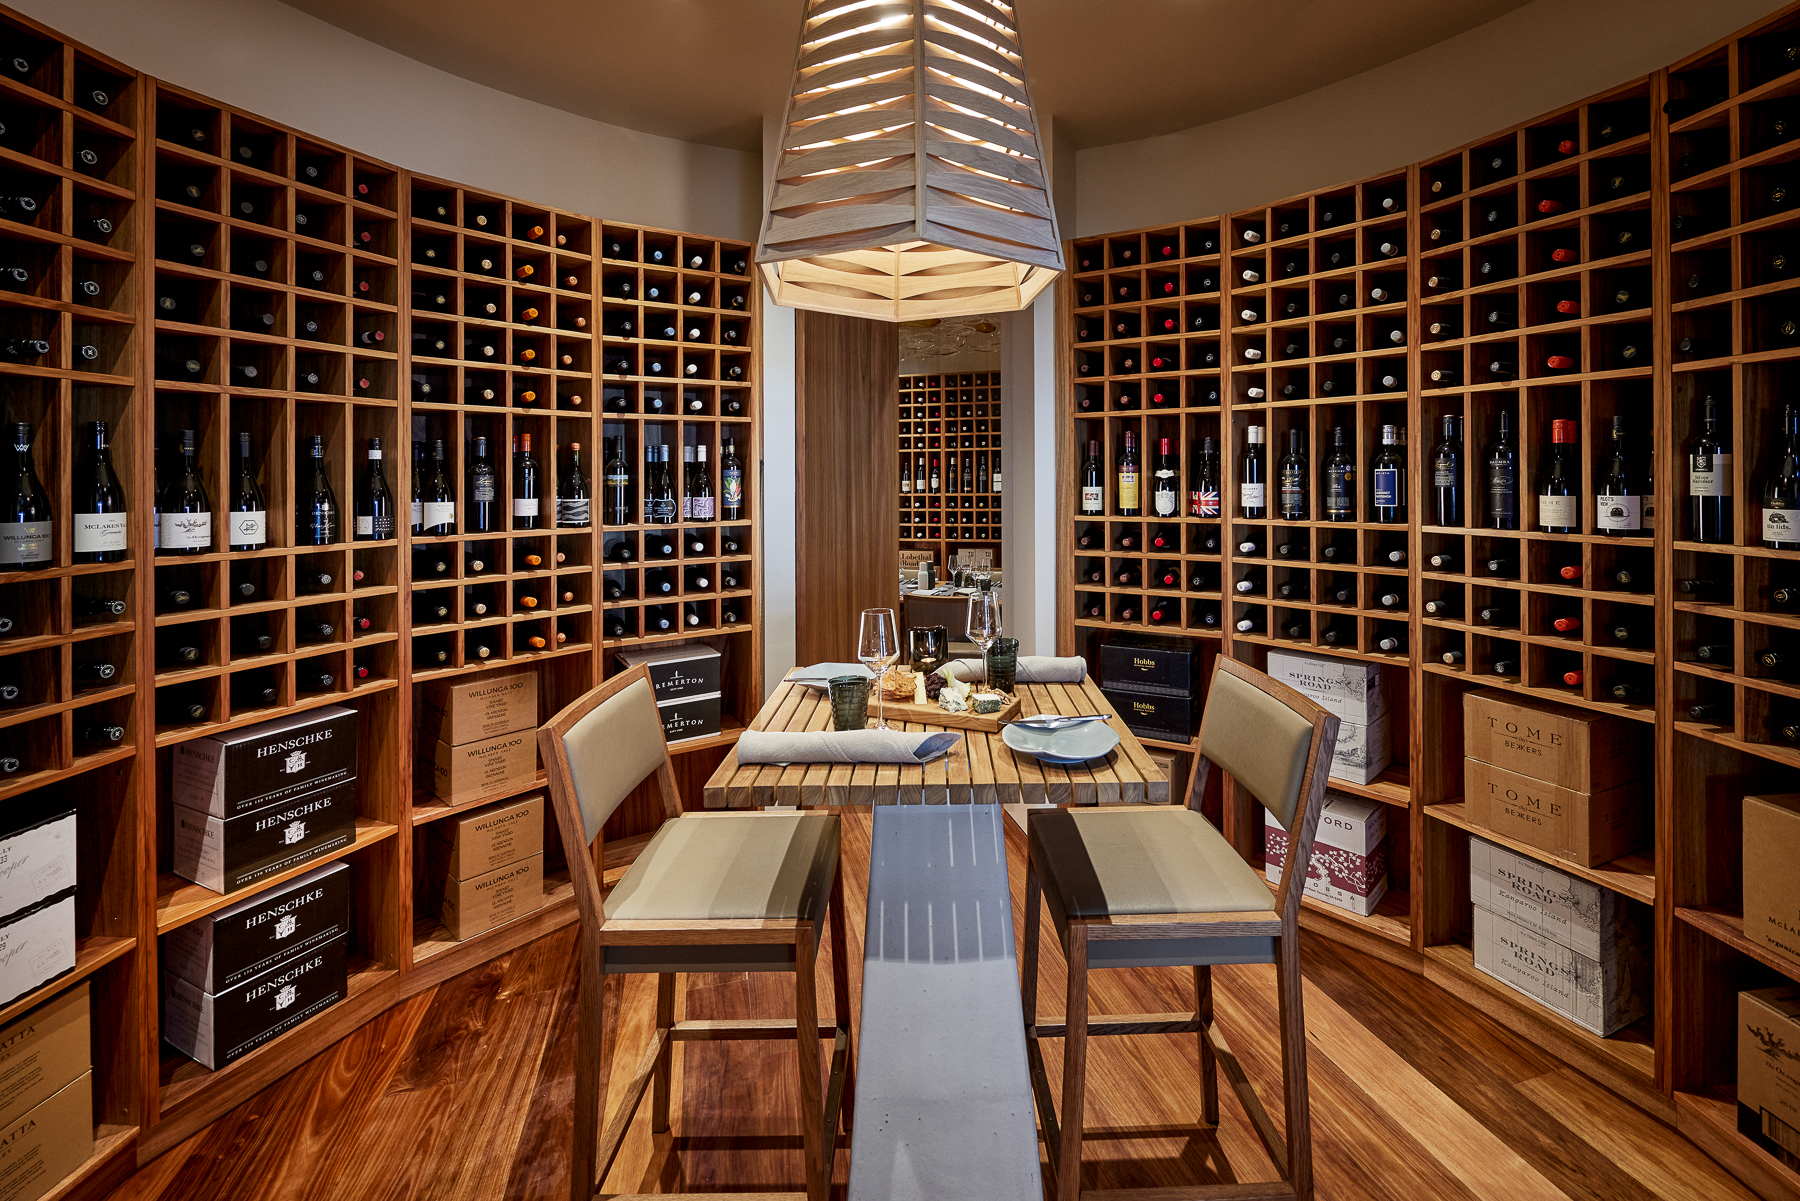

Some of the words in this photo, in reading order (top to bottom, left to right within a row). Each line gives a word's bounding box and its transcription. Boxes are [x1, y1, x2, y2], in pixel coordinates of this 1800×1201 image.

[1134, 658, 1156, 666] Hobbs
[468, 686, 508, 698] WILLUNGA
[510, 682, 524, 690] 100
[656, 678, 704, 690] REMERTON
[1289, 672, 1342, 686] SPRINGS
[1300, 680, 1332, 690] ROAD
[1133, 702, 1155, 710] Hobbs
[1322, 694, 1342, 704] Island
[256, 729, 333, 758] HENSCHKE
[1487, 716, 1562, 746] TOME
[186, 748, 216, 764] HENSCHKE
[468, 743, 507, 757] WILLUNGA
[508, 738, 522, 746] 100
[1504, 740, 1542, 757] BEKKERS
[236, 802, 252, 810] OVER
[265, 792, 282, 801] YEARS
[294, 782, 313, 792] FAMILY
[314, 771, 347, 784] WINEMAKING
[1488, 782, 1562, 817] TOME
[255, 797, 332, 832] HENSCHKE
[475, 815, 514, 831] WILLUNGA
[516, 810, 529, 818] 100
[1504, 807, 1542, 826] BEKKERS
[236, 876, 252, 884] OVER
[265, 864, 282, 873] YEARS
[293, 852, 312, 862] FAMILY
[314, 838, 347, 853] WINEMAKING
[475, 872, 514, 890] WILLUNGA
[516, 866, 529, 875] 100
[1498, 868, 1568, 902] SPRINGS
[1512, 881, 1553, 904] ROAD
[246, 888, 324, 929] HENSCHKE
[1499, 890, 1537, 911] Kangaroo
[1540, 909, 1568, 925] Island
[226, 974, 241, 984] OVER
[255, 960, 272, 970] YEARS
[284, 945, 304, 956] FAMILY
[304, 928, 339, 946] WINEMAKING
[1500, 936, 1569, 976] SPRINGS
[1514, 951, 1554, 976] ROAD
[246, 956, 324, 1003] HENSCHKE
[1501, 958, 1539, 982] Kangaroo
[1543, 980, 1569, 999] Island
[227, 1048, 242, 1059] OVER
[255, 1031, 273, 1042] YEARS
[284, 1014, 304, 1026] FAMILY
[305, 994, 339, 1015] WINEMAKING
